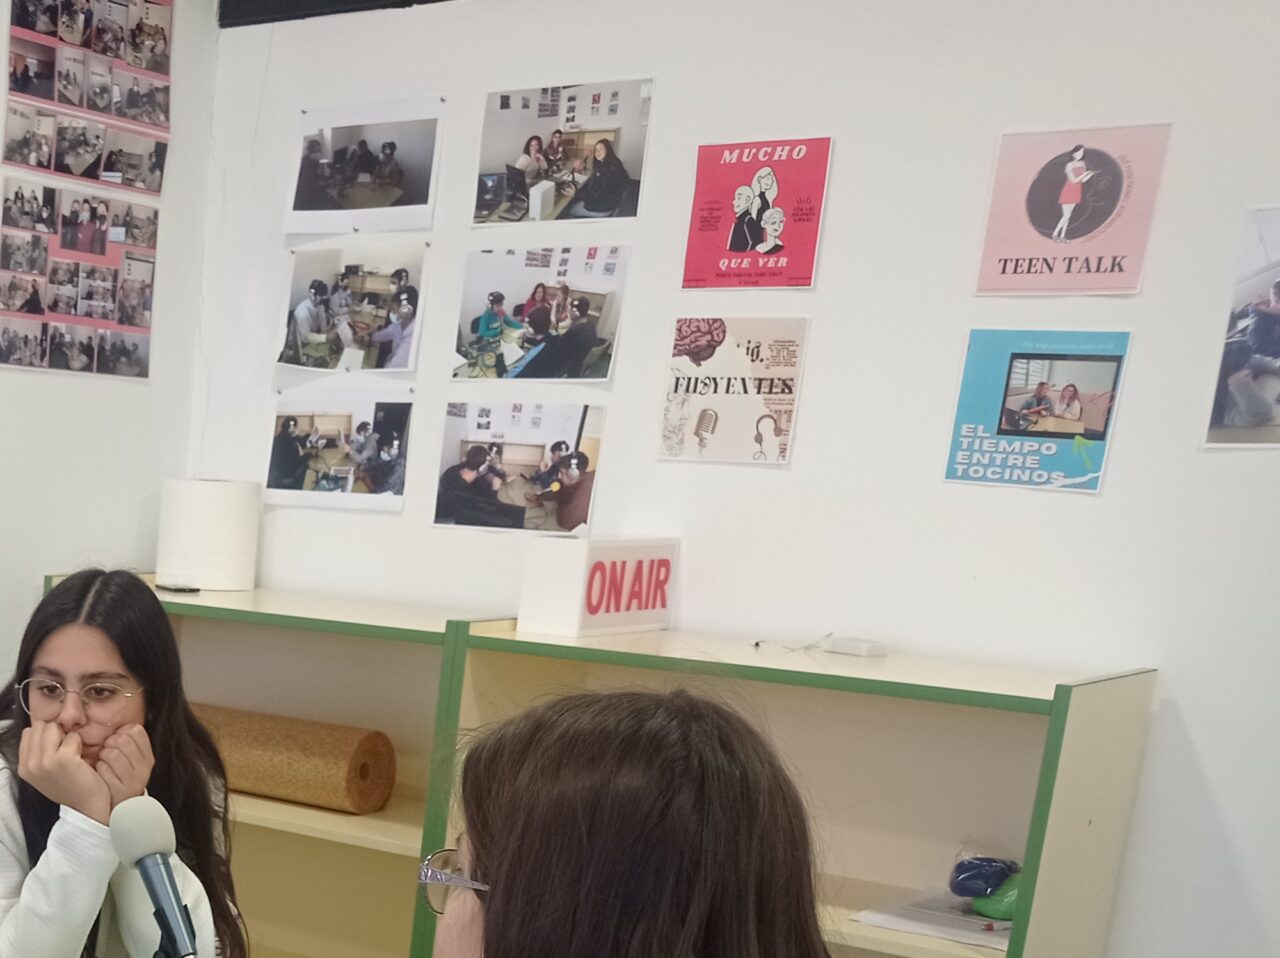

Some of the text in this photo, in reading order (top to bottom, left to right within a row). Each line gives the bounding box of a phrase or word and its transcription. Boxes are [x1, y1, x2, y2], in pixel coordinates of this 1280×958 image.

[720, 145, 807, 164] MUCHO
[719, 257, 789, 271] QUE VER
[998, 255, 1128, 275] TEEN TALK
[960, 424, 991, 438] EL
[958, 437, 1058, 455] TIEMPO
[955, 451, 1041, 468] ENTRE
[953, 464, 1066, 484] TOCINOS
[586, 558, 672, 616] ON AIR
